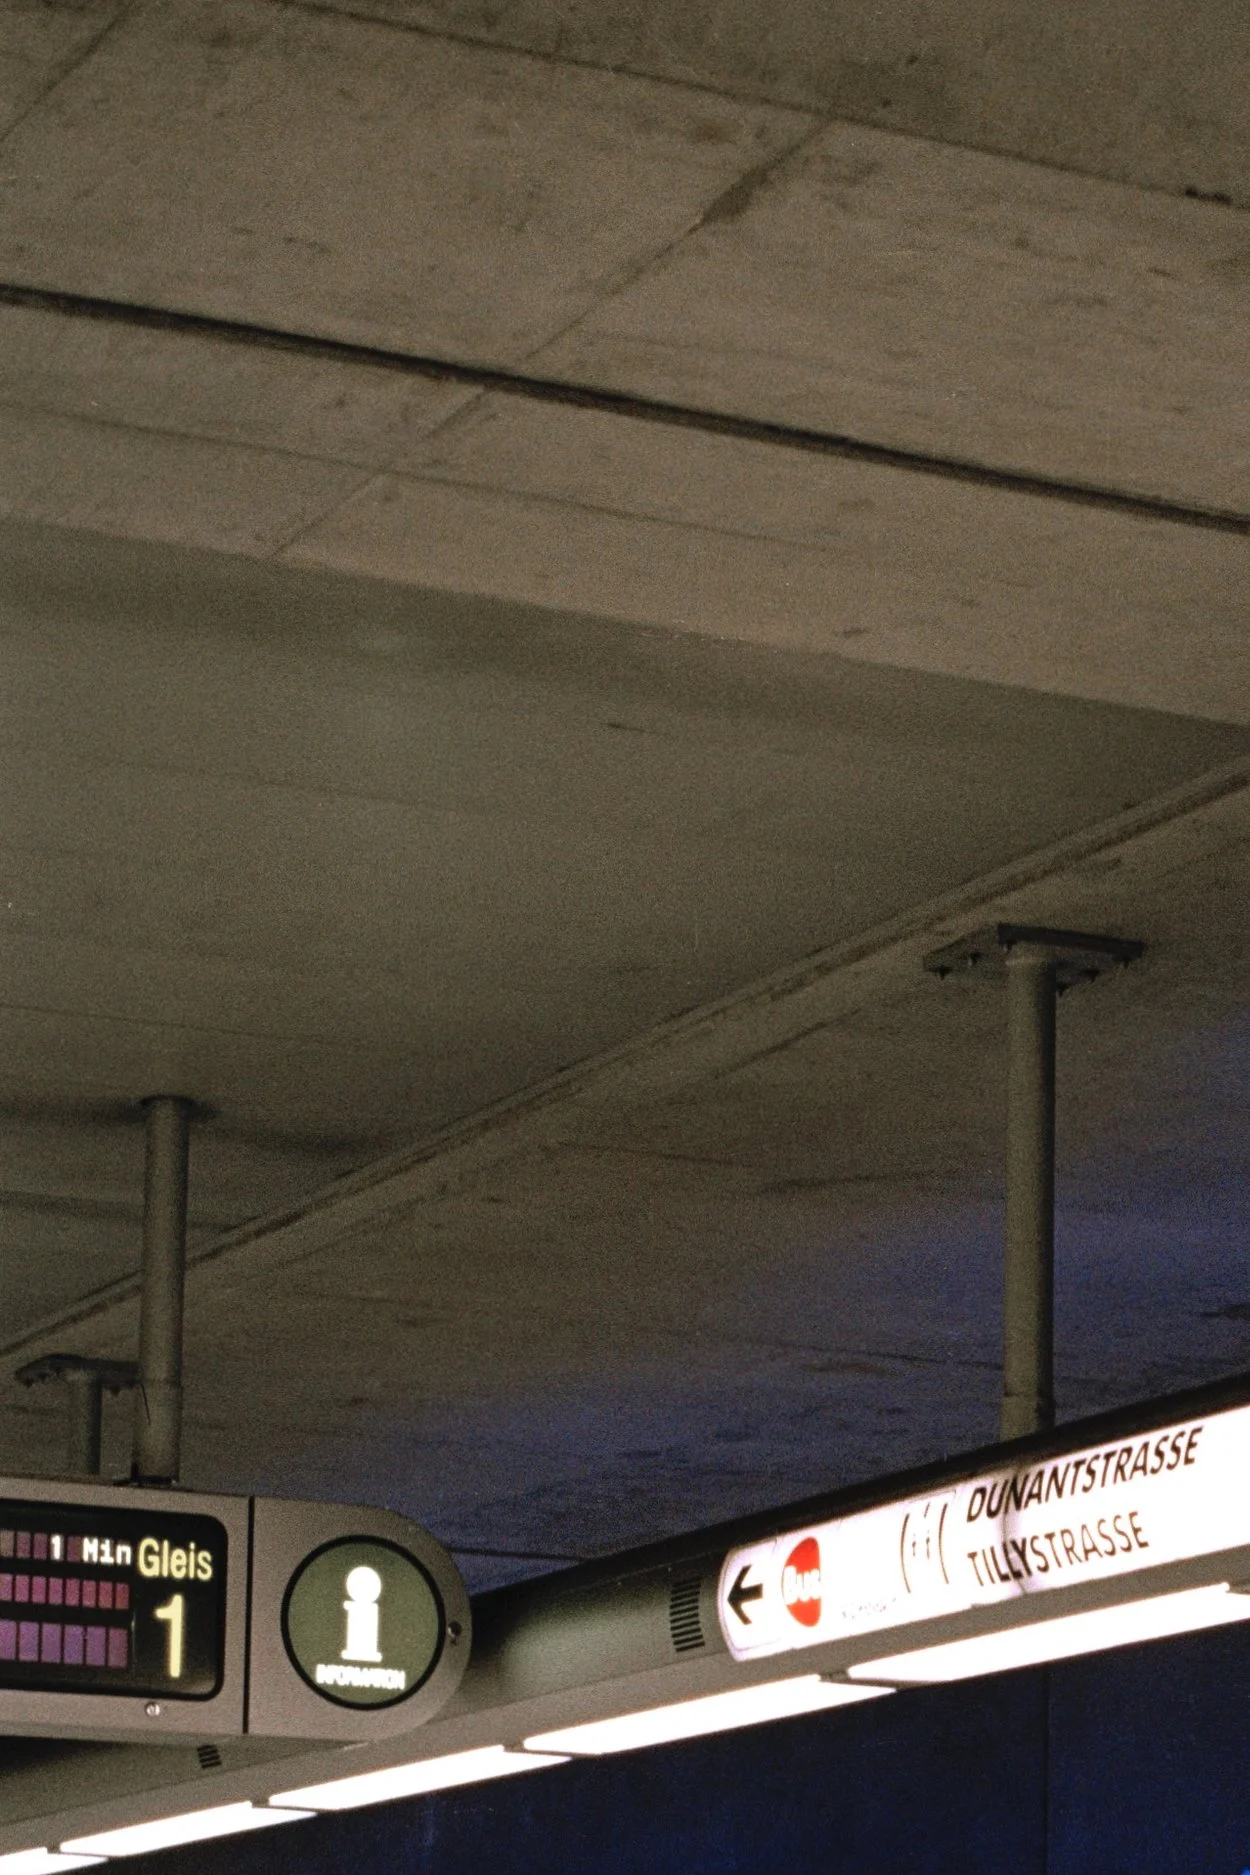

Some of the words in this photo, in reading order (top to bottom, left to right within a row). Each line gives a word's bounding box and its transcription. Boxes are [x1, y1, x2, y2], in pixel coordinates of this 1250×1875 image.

[966, 1426, 1204, 1523] DUNANTSTRASSE
[51, 1534, 63, 1561] 1
[82, 1536, 132, 1565] Min
[137, 1537, 213, 1581] Gleis
[967, 1511, 1150, 1587] TILLYSTRASSE
[155, 1594, 183, 1678] 1
[315, 1663, 406, 1690] INFORMATION
